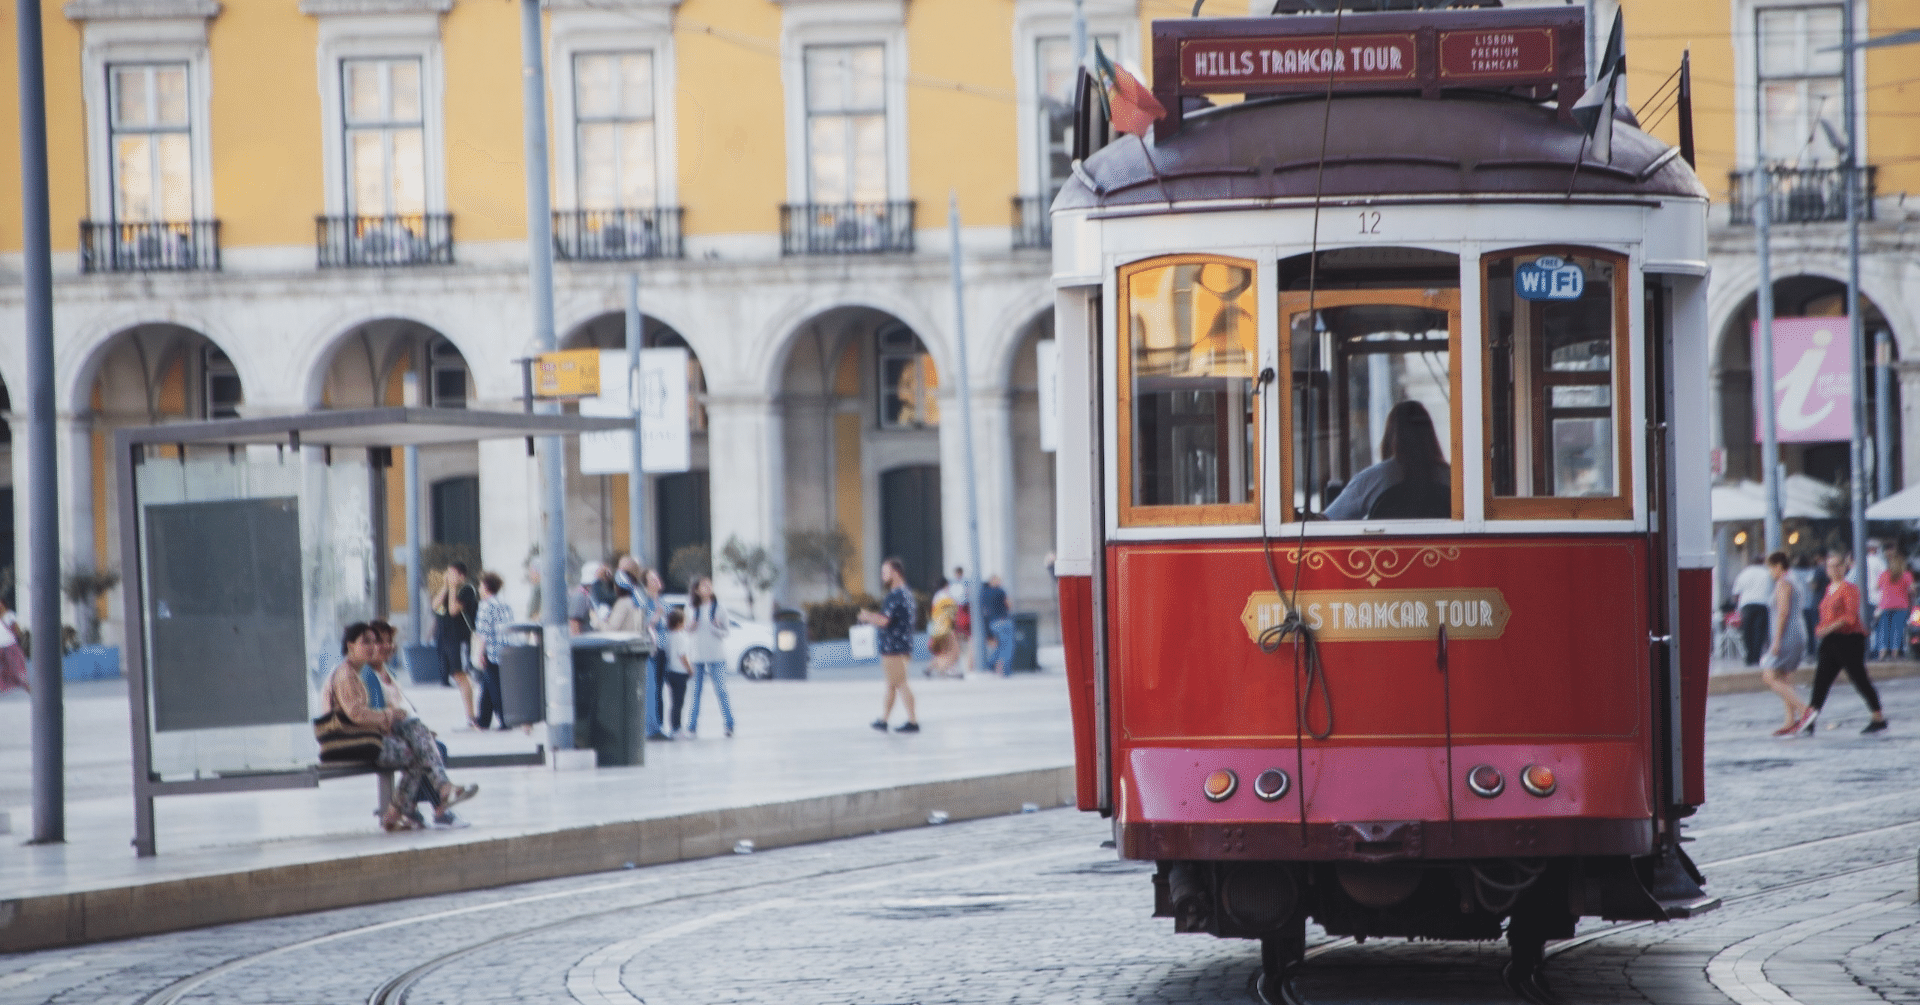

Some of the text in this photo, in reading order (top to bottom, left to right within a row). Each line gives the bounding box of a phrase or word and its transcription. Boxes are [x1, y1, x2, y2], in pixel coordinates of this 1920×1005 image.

[1475, 34, 1514, 46] LISBON
[1195, 46, 1402, 76] HILLS TRAMCAR TOUR
[1471, 46, 1519, 59] PREMIUM
[1471, 59, 1519, 71] TRAMCAR
[1359, 211, 1381, 234] 12
[1257, 600, 1493, 631] HIS TRAMCAR TOUR
